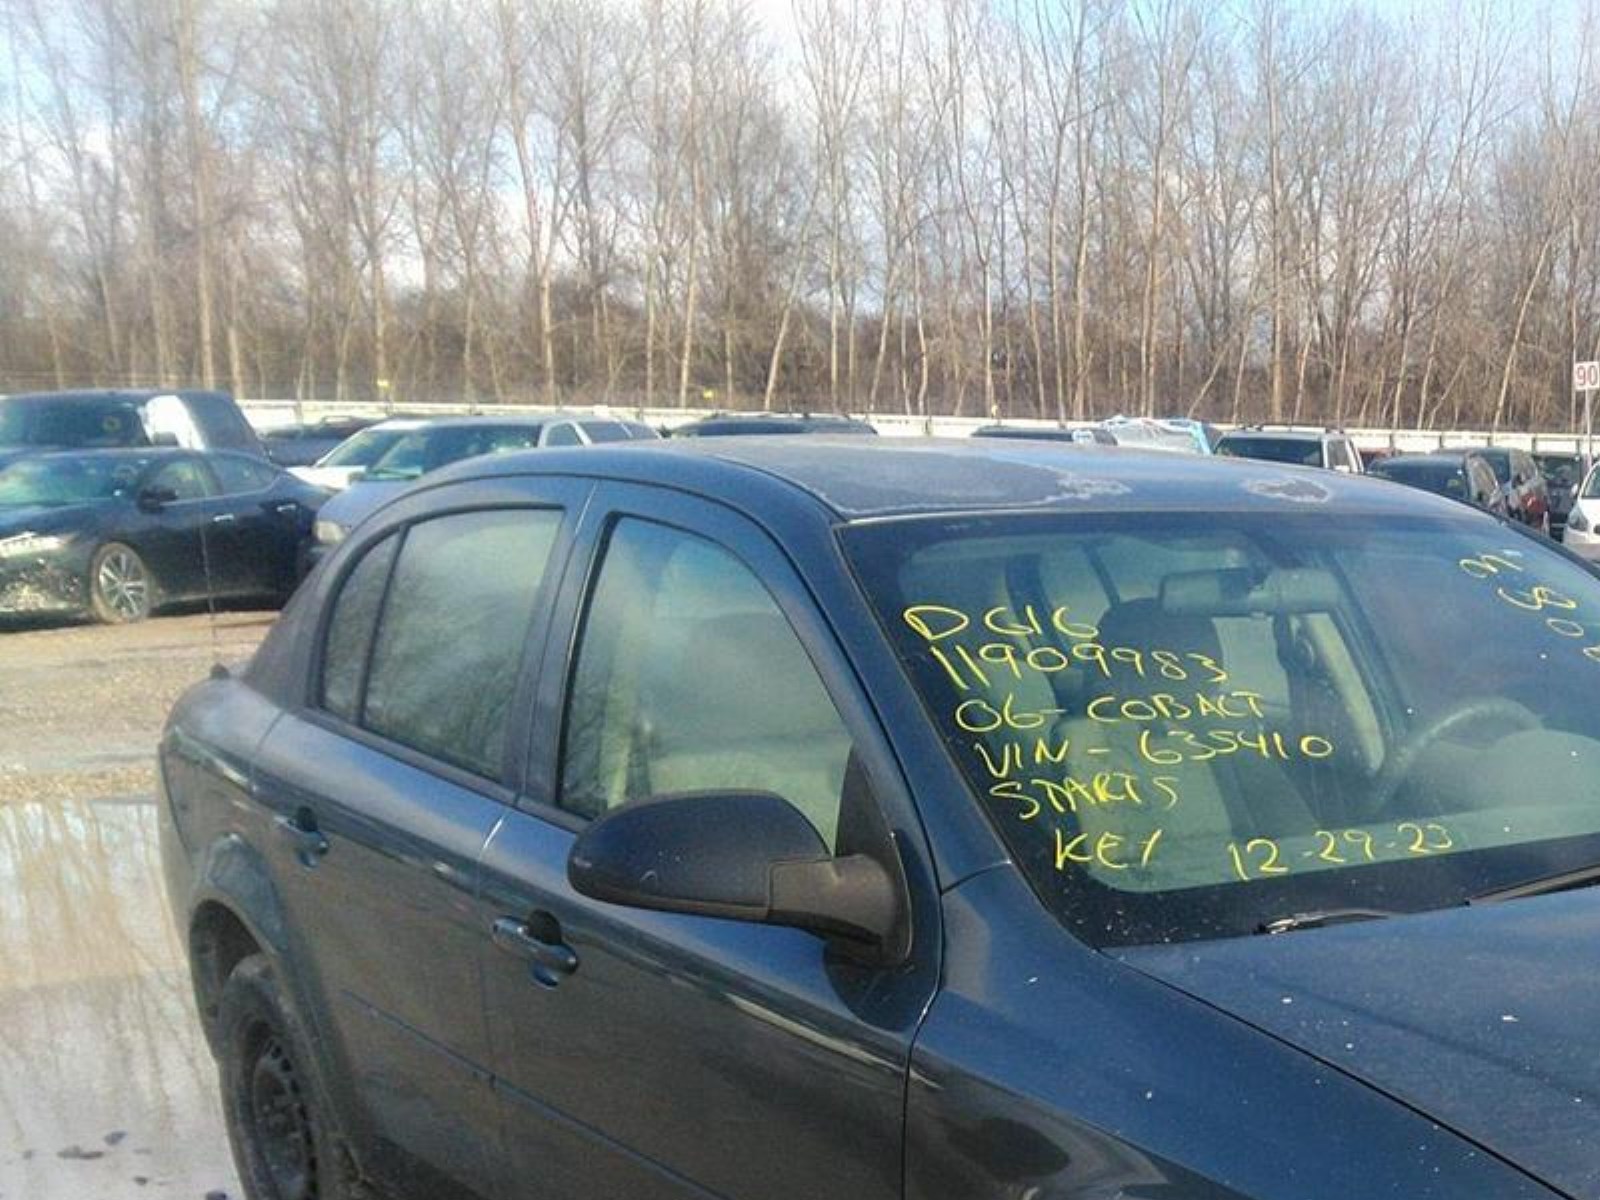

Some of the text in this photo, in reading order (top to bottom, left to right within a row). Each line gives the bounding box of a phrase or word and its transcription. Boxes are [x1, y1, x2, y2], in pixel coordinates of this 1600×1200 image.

[1577, 365, 1598, 386] 90
[930, 642, 1229, 691] 11909983
[974, 737, 1070, 779] VIN
[1140, 729, 1333, 764] 635410
